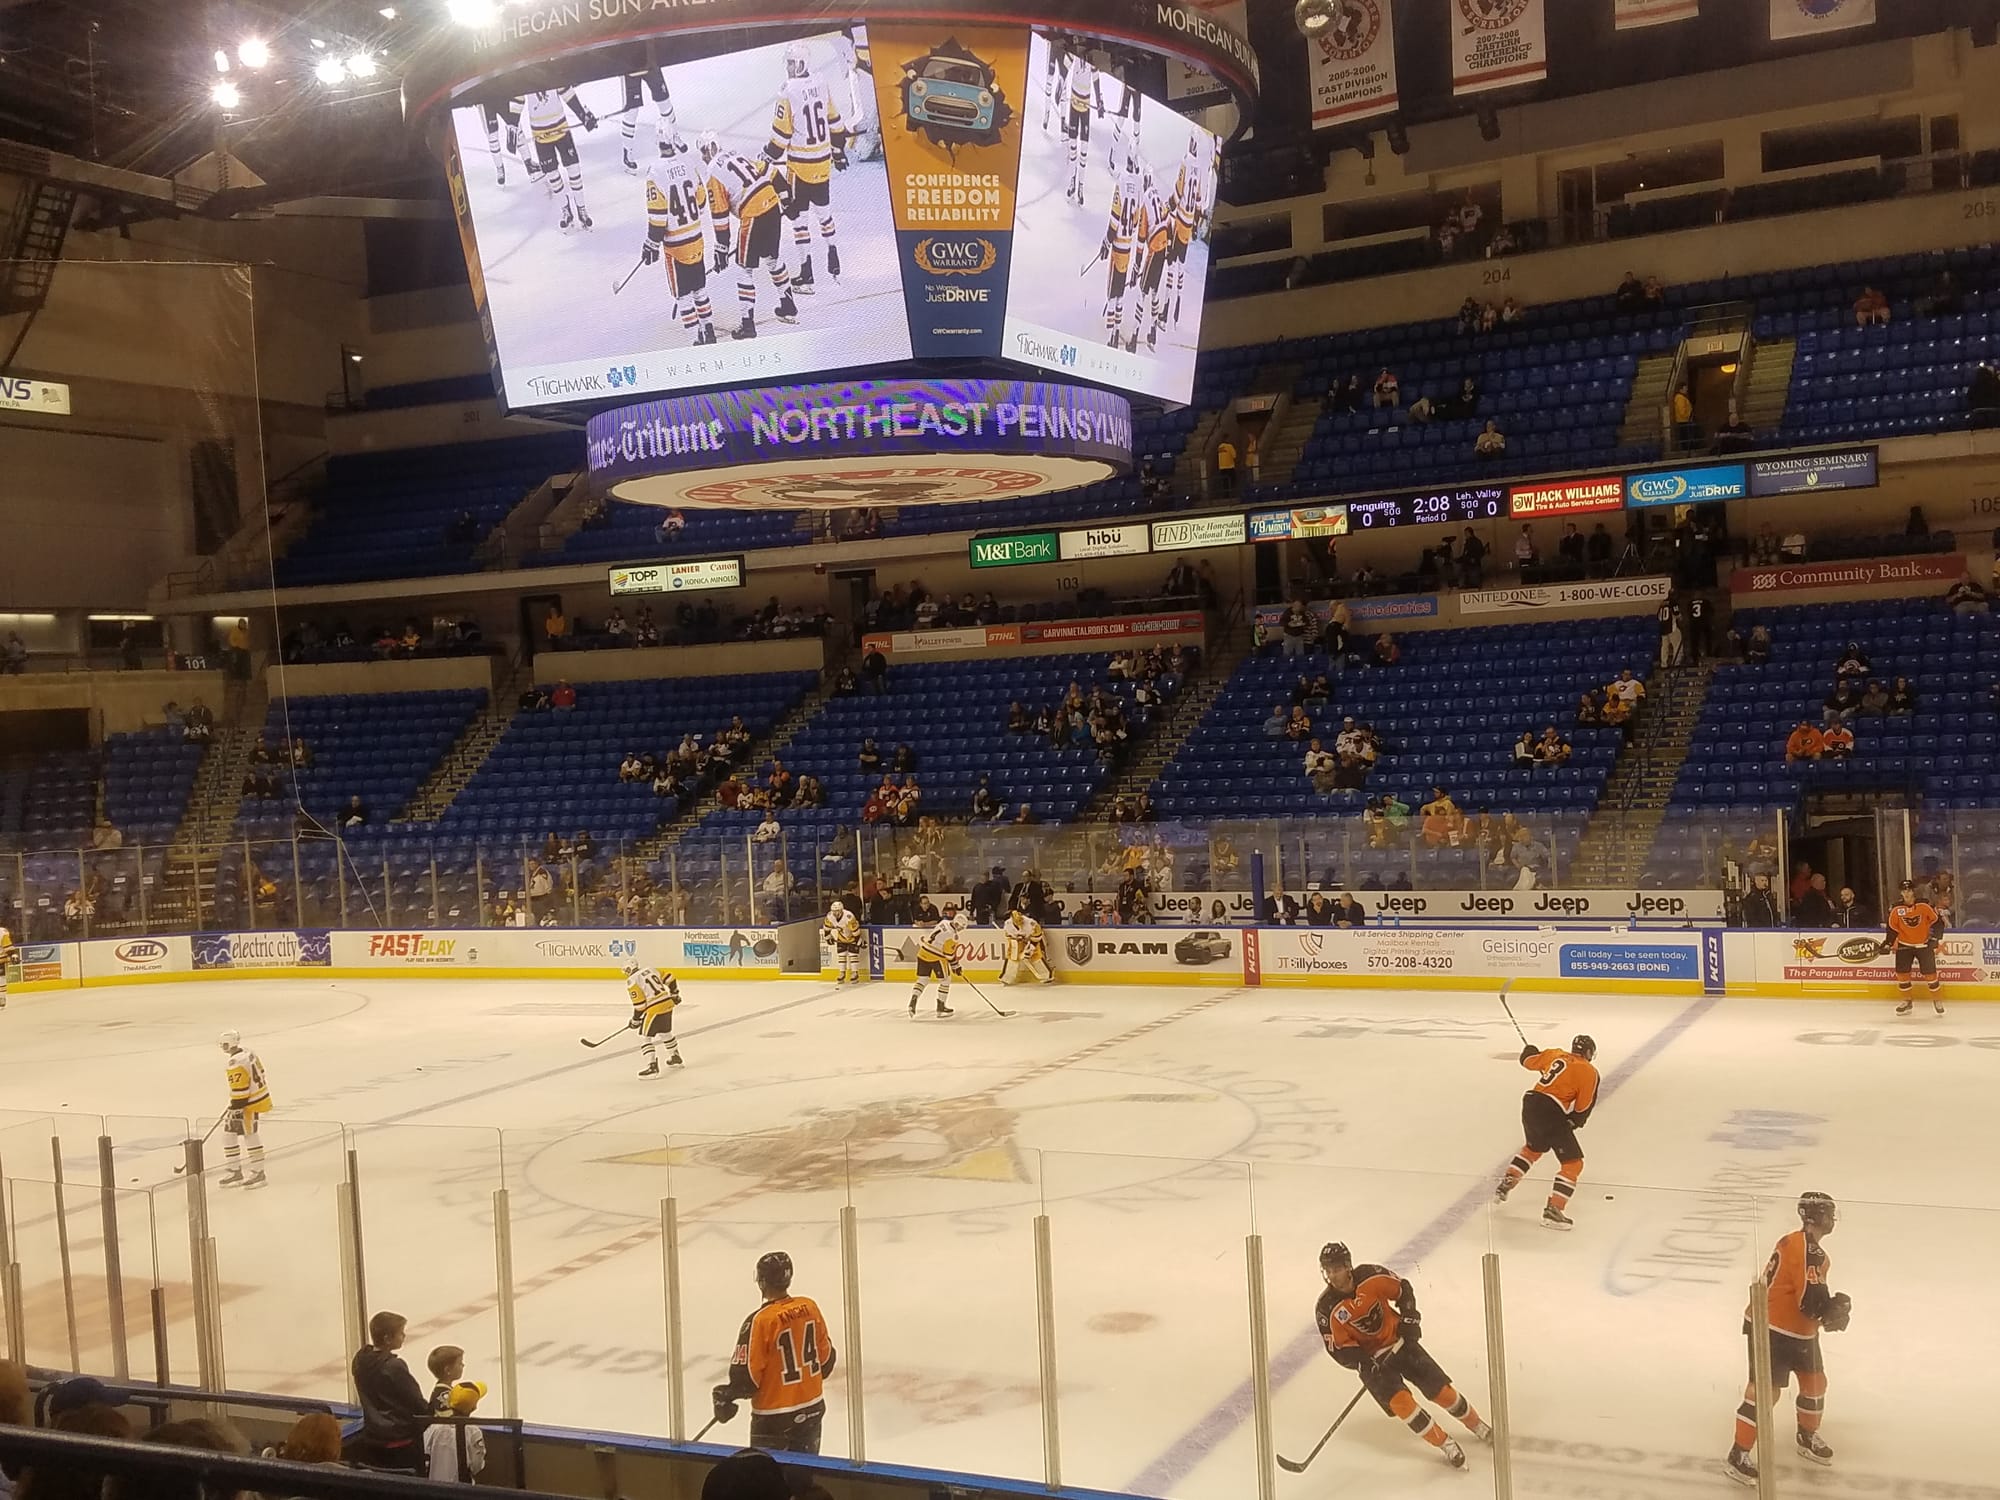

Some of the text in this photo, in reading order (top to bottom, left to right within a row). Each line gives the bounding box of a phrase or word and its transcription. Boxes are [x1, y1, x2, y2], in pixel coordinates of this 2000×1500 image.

[1157, 4, 1233, 53] MOHEGAN
[1477, 29, 1520, 44] 2007-2008
[1464, 43, 1533, 62] CONFERENCE
[1475, 38, 1521, 52] EASTERN
[1468, 52, 1529, 70] CHAMPIONS
[1328, 64, 1376, 82] 2005-2006
[1318, 71, 1388, 95] EAST DIVISION
[1325, 85, 1383, 105] CHAMPIONS
[802, 100, 826, 145] 16
[905, 174, 1000, 187] CONFIDENCE
[670, 179, 699, 227] 46
[906, 189, 1000, 205] FREEDOM
[907, 208, 1000, 221] RELIABILITY
[1964, 203, 1996, 219] 205
[932, 242, 978, 259] GWC
[1483, 269, 1511, 285] 204
[527, 376, 604, 397] HIGHMARK
[751, 403, 988, 446] NORTHEAST
[1756, 453, 1869, 471] WYOMING SEMINARY
[1536, 484, 1620, 503] JACK WILLIAMS
[1642, 479, 1674, 491] GWC
[1350, 490, 1502, 514] Penguins 2:08 Leh. Valley
[1384, 500, 1479, 516] SOG SOG
[1363, 501, 1497, 527] 0 0
[1389, 510, 1474, 526] 0 Period 0 0
[1192, 520, 1244, 531] The Honesdale
[1193, 528, 1243, 539] National Bank
[1087, 529, 1121, 545] hibü
[1158, 526, 1188, 543] HNB
[976, 539, 1051, 562] M&T Bank
[629, 570, 658, 582] TOPP
[671, 563, 737, 574] LANIER Canon
[1780, 566, 1876, 585] Community
[1880, 561, 1921, 578] Bank
[684, 575, 738, 586] KONICA MINOLTA
[1056, 577, 1079, 591] 103
[1463, 592, 1507, 604] UNITED
[1510, 590, 1537, 601] ONE
[1559, 583, 1665, 601] 1-800-WE-CLOSE
[1693, 604, 1702, 618] 3
[988, 632, 1015, 641] STIHL
[185, 658, 207, 670] 101
[1376, 893, 1427, 914] Jeep
[1460, 893, 1514, 914] Jeep
[1534, 893, 1590, 914] Jeep
[1627, 893, 1684, 914] Jeep
[684, 931, 720, 940] Northeast
[1398, 931, 1433, 939] Shipping
[126, 943, 159, 957] AHL
[232, 934, 298, 961] electric city
[535, 939, 604, 957] HIGHMARK
[685, 944, 719, 956] NEWS
[954, 942, 988, 961] ors
[1098, 942, 1168, 955] RAM
[1246, 933, 1256, 974] CCM
[1390, 948, 1420, 956] Printing
[1482, 938, 1554, 958] Geisinger
[1570, 950, 1587, 959] Call
[1588, 951, 1612, 961] today
[1624, 951, 1637, 959] be
[1661, 951, 1688, 961] today.
[695, 956, 725, 966] TEAM
[1367, 956, 1453, 968] 570-208-4320
[1571, 962, 1670, 973] 855-949-2663 (BONE)
[1708, 936, 1720, 982] CCM
[1789, 969, 1807, 977] The
[1809, 969, 1853, 978] Penguins
[1936, 970, 1960, 978] Team
[1539, 1058, 1566, 1087] 3
[777, 1304, 810, 1324] KNIGHT
[732, 1344, 748, 1364] 14
[777, 1320, 822, 1386] 14
